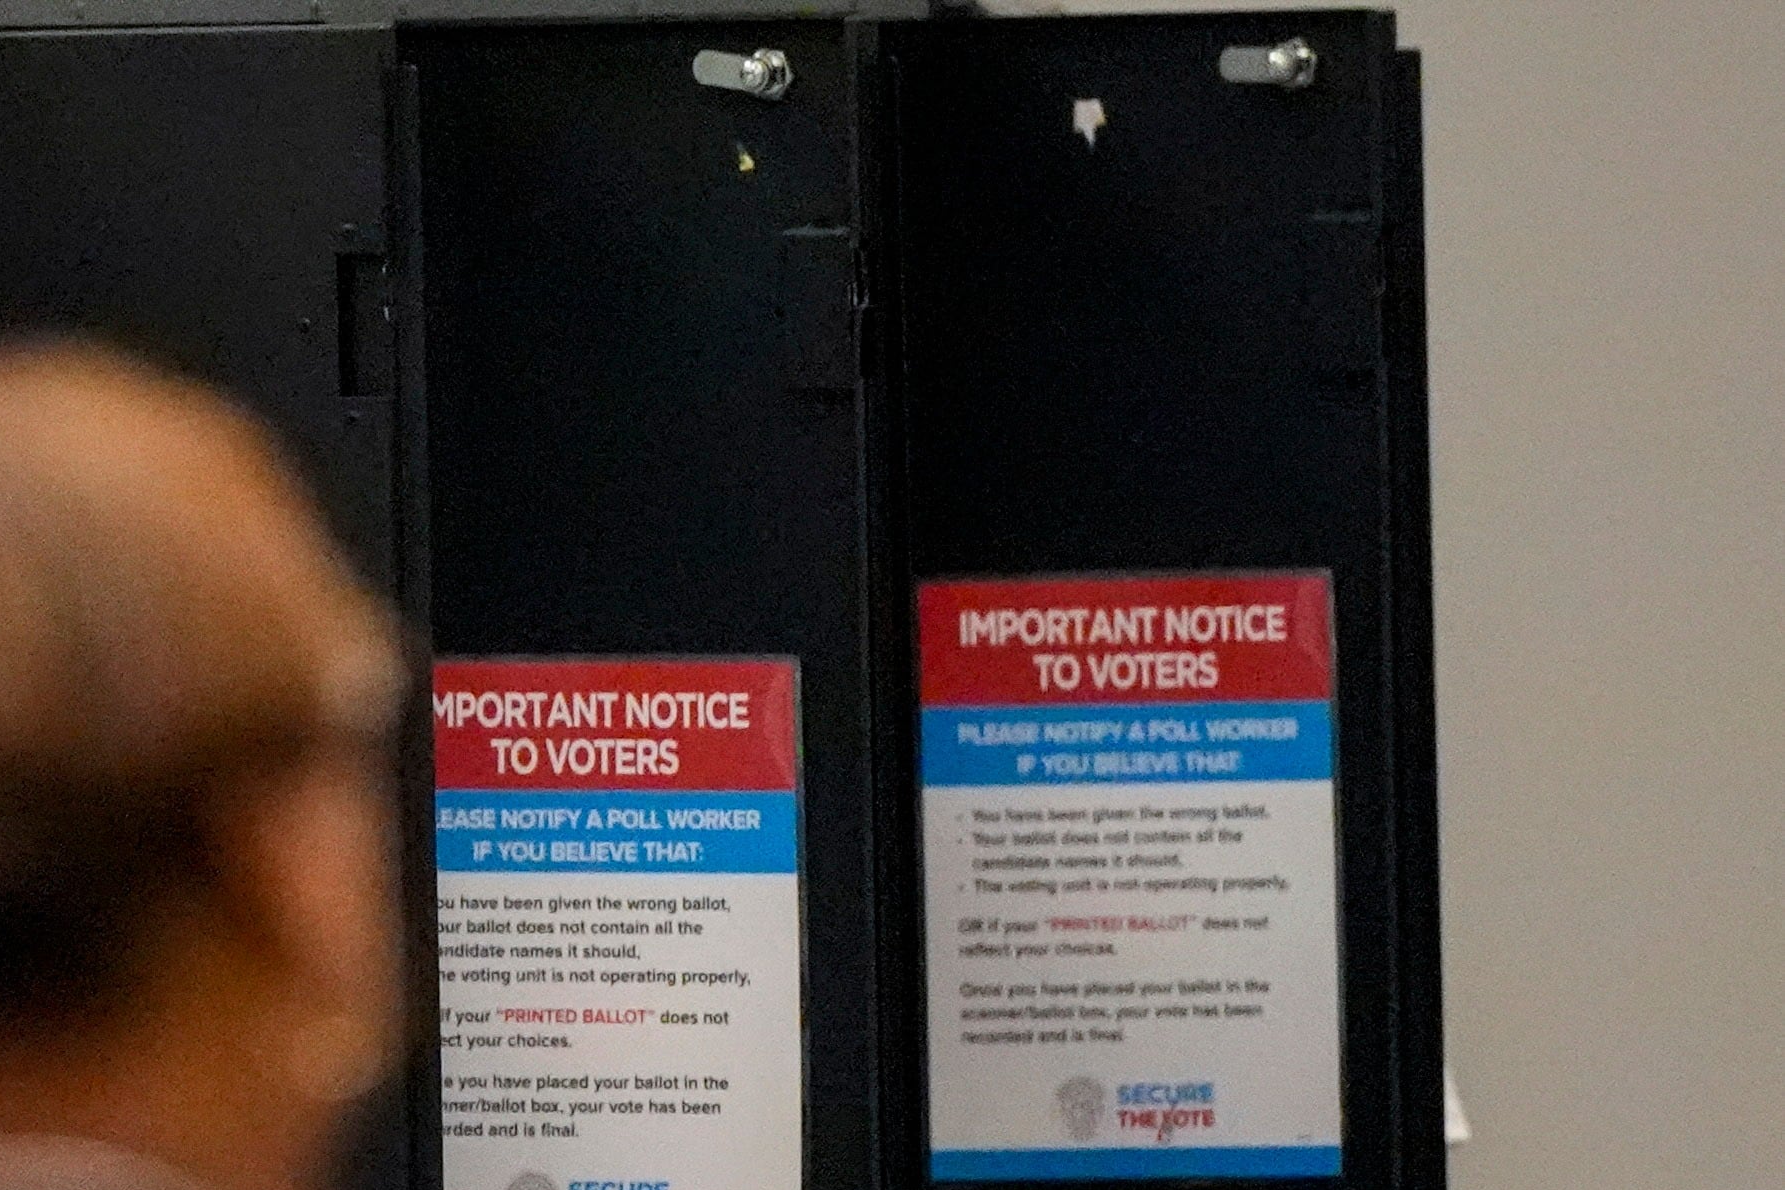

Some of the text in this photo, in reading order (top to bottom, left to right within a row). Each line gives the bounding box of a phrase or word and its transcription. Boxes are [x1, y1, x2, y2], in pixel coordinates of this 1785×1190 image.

[959, 604, 1287, 647] IMPORTANT NOTICE
[1033, 651, 1219, 693] TO VOTERS
[432, 690, 750, 730] MPORTANT NOTICE
[490, 737, 679, 776] TO VOTERS
[436, 808, 761, 831] EASE NOTIFY A POLL WORKER
[472, 840, 704, 863] IF YOU BELIEVE THAT:
[437, 895, 731, 914] ou have been given the wrong ballot,
[438, 919, 703, 935] our ballot does not contain all the
[439, 944, 505, 958] andidate
[510, 945, 563, 958] names
[568, 944, 578, 958] it
[462, 968, 510, 985] voting
[516, 968, 546, 982] unit
[551, 968, 564, 982] is
[569, 969, 596, 983] not
[600, 969, 677, 987] operating
[455, 1011, 491, 1026] your
[660, 1010, 698, 1025] does
[703, 1011, 730, 1025] not
[466, 1035, 502, 1051] your
[507, 1033, 572, 1048] choices.
[458, 1077, 487, 1092] you
[493, 1074, 531, 1089] have
[536, 1074, 589, 1091] placed
[593, 1078, 629, 1093] your
[634, 1075, 680, 1090] ballot
[684, 1075, 698, 1090] in
[703, 1075, 729, 1091] the
[568, 1102, 603, 1117] your
[609, 1101, 644, 1114] vote
[648, 1099, 677, 1114] has
[682, 1098, 722, 1115] been
[488, 1122, 518, 1137] and
[524, 1122, 536, 1137] is
[541, 1122, 580, 1138] final.
